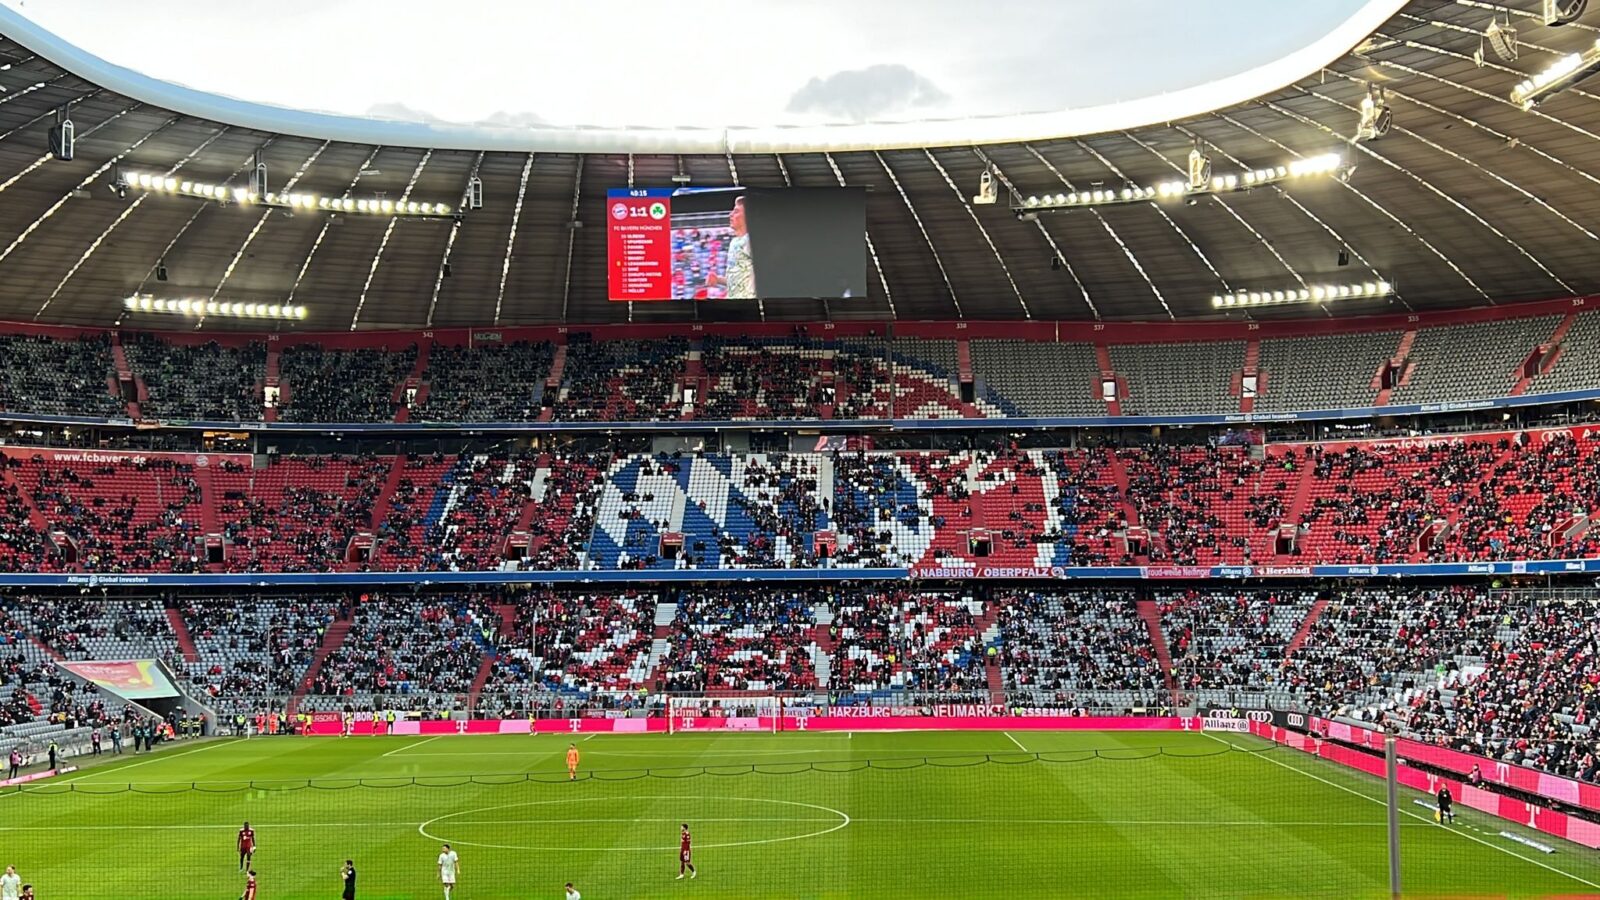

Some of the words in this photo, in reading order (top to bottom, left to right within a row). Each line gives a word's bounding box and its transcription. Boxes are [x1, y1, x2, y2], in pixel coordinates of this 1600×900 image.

[630, 206, 648, 217] 1:1
[920, 568, 974, 578] NABBURG
[984, 567, 1049, 577] OBERPFALZ
[119, 575, 149, 583] Investors
[828, 706, 890, 718] HARZBURG
[1204, 719, 1236, 729] Allianz
